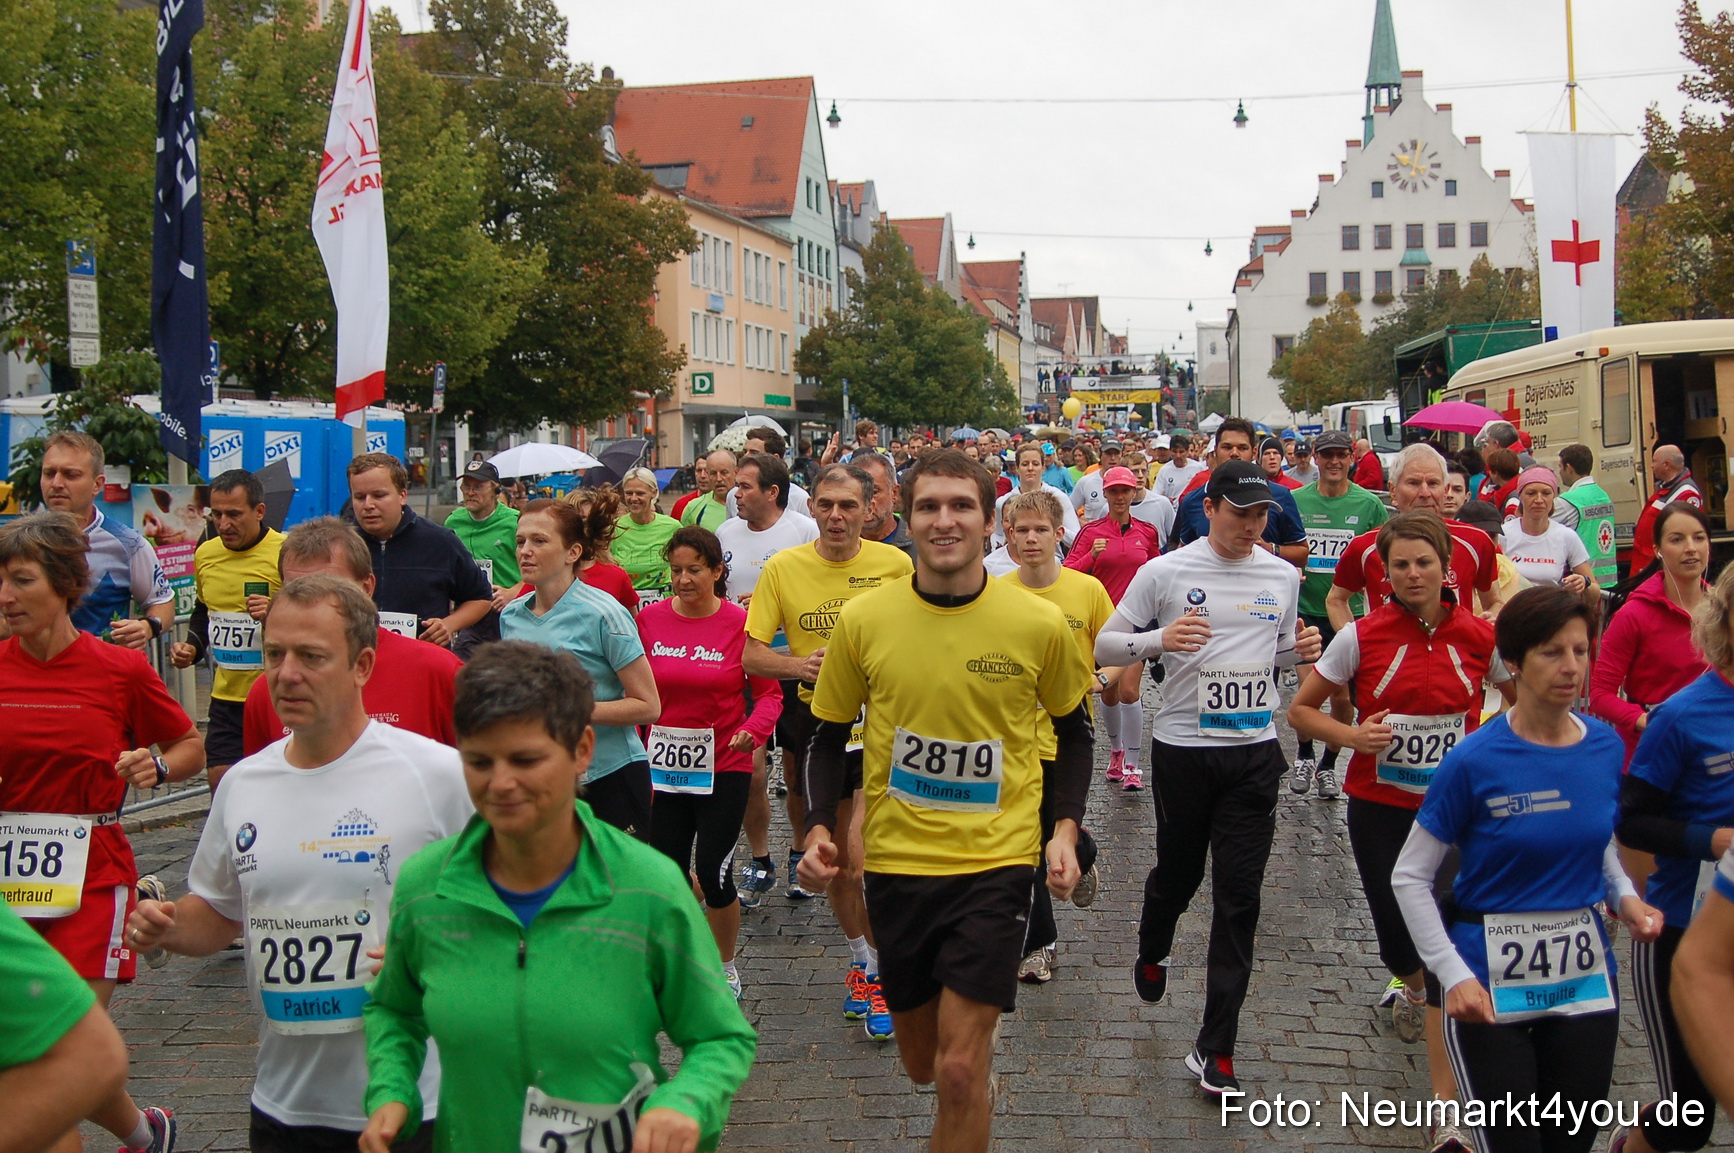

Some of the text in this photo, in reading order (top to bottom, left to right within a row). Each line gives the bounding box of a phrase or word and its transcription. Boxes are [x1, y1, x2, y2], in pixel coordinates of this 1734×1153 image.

[694, 375, 710, 391] D
[1525, 378, 1575, 406] Bayerisches
[1100, 393, 1131, 402] START
[1524, 408, 1548, 427] Rotes
[1309, 539, 1349, 556] 2172
[212, 625, 256, 648] 2757
[222, 652, 243, 662] Albert
[652, 641, 724, 662] Sweet Pain
[973, 660, 1019, 676] FRANCESCO
[1229, 670, 1262, 678] Neumarkt
[1207, 680, 1267, 709] 3012
[1210, 716, 1264, 727] Maximilian
[1412, 722, 1451, 731] Neumarkt
[669, 734, 701, 742] Neumarkt
[652, 742, 707, 769] 2662
[902, 735, 993, 778] 2819
[1386, 732, 1457, 765] 2928
[665, 773, 688, 784] Petra
[915, 779, 971, 800] Thomas
[16, 826, 69, 837] Neumarkt
[300, 841, 320, 853] 14.
[0, 840, 64, 878] 158
[250, 915, 349, 930] PARTL Neumarkt
[1488, 918, 1579, 936] PARTL Neumarkt
[260, 932, 363, 985] 2827
[1501, 931, 1595, 981] 2478
[1525, 986, 1576, 1007] Brigitte
[283, 996, 342, 1017] Patrick
[528, 1103, 580, 1126] PARTL
